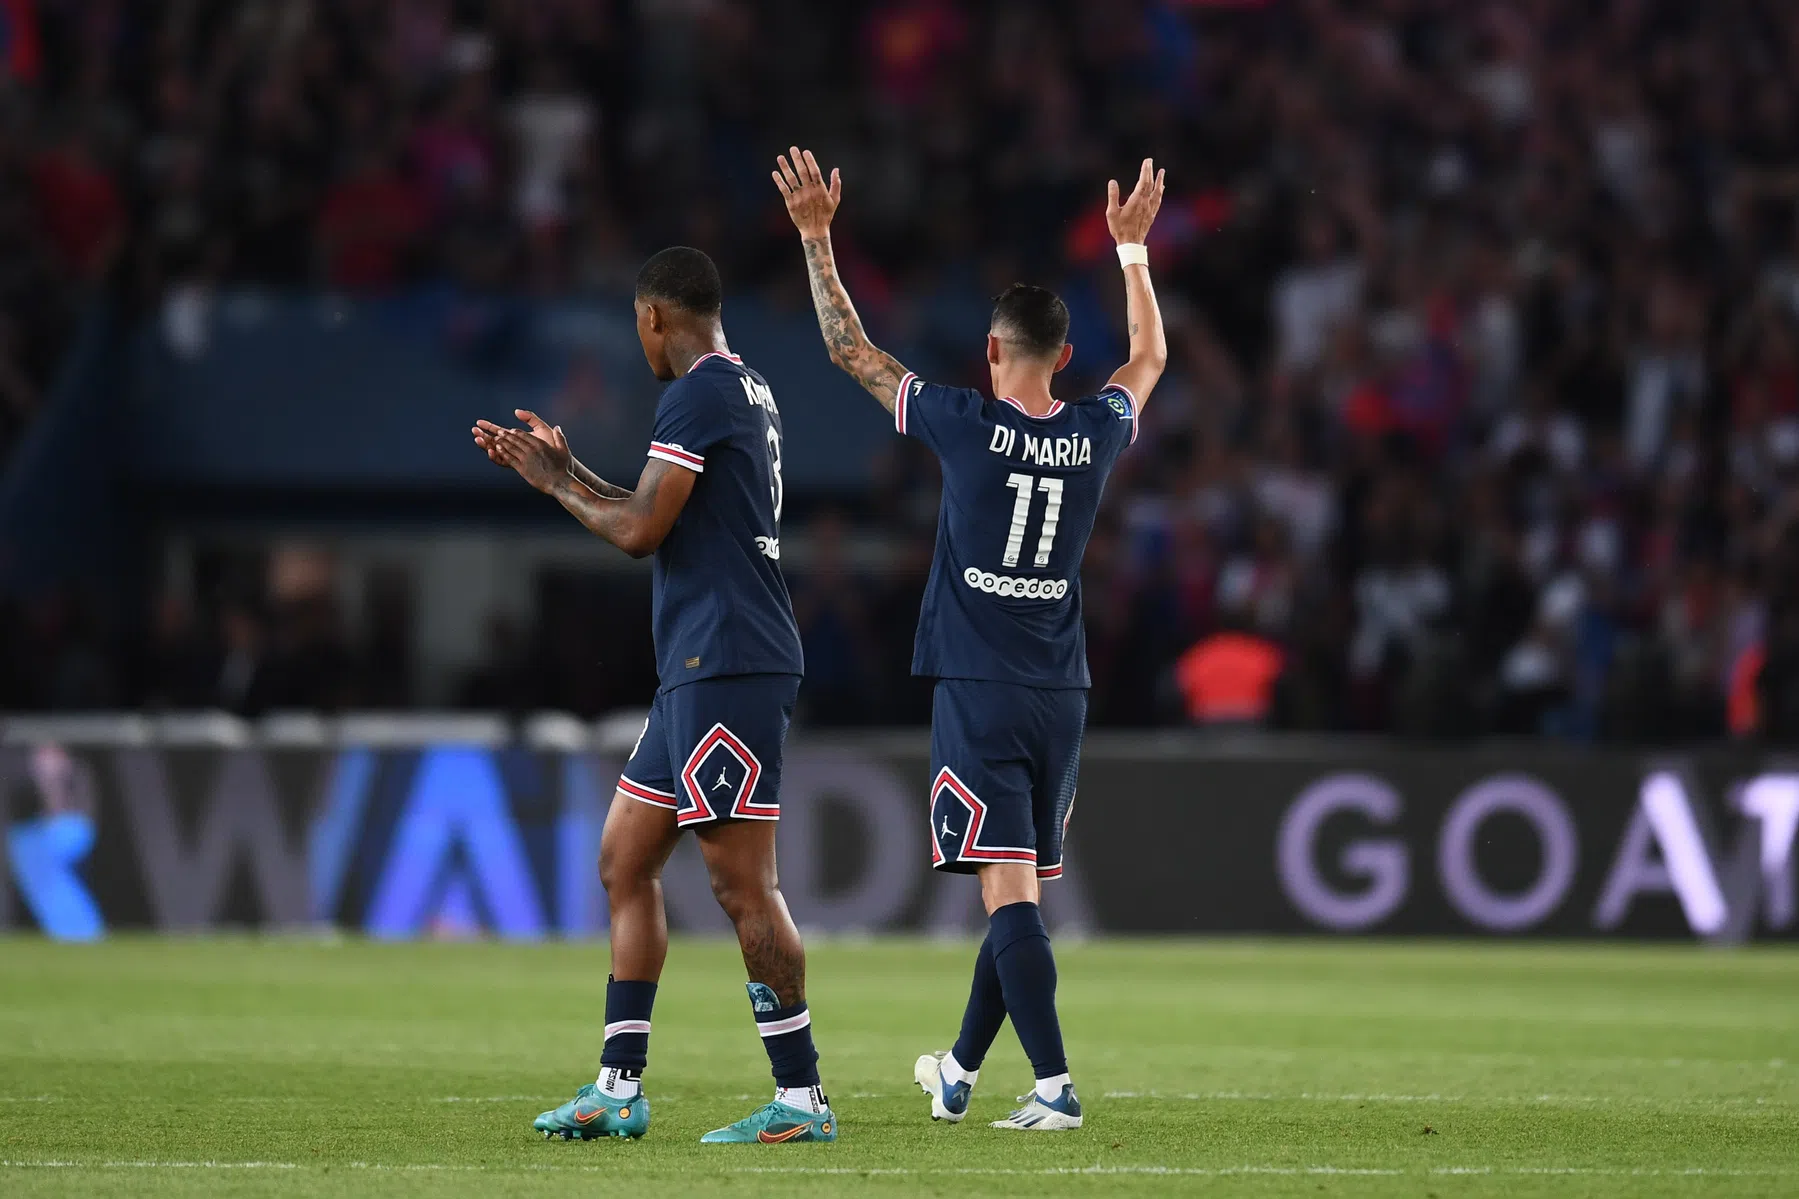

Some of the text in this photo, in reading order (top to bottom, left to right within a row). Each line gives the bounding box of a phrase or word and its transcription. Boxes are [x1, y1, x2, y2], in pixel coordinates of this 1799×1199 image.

[767, 426, 783, 522] 3
[989, 424, 1091, 466] DI MARÍA
[1002, 473, 1063, 567] 11
[965, 568, 1066, 598] ooredoo
